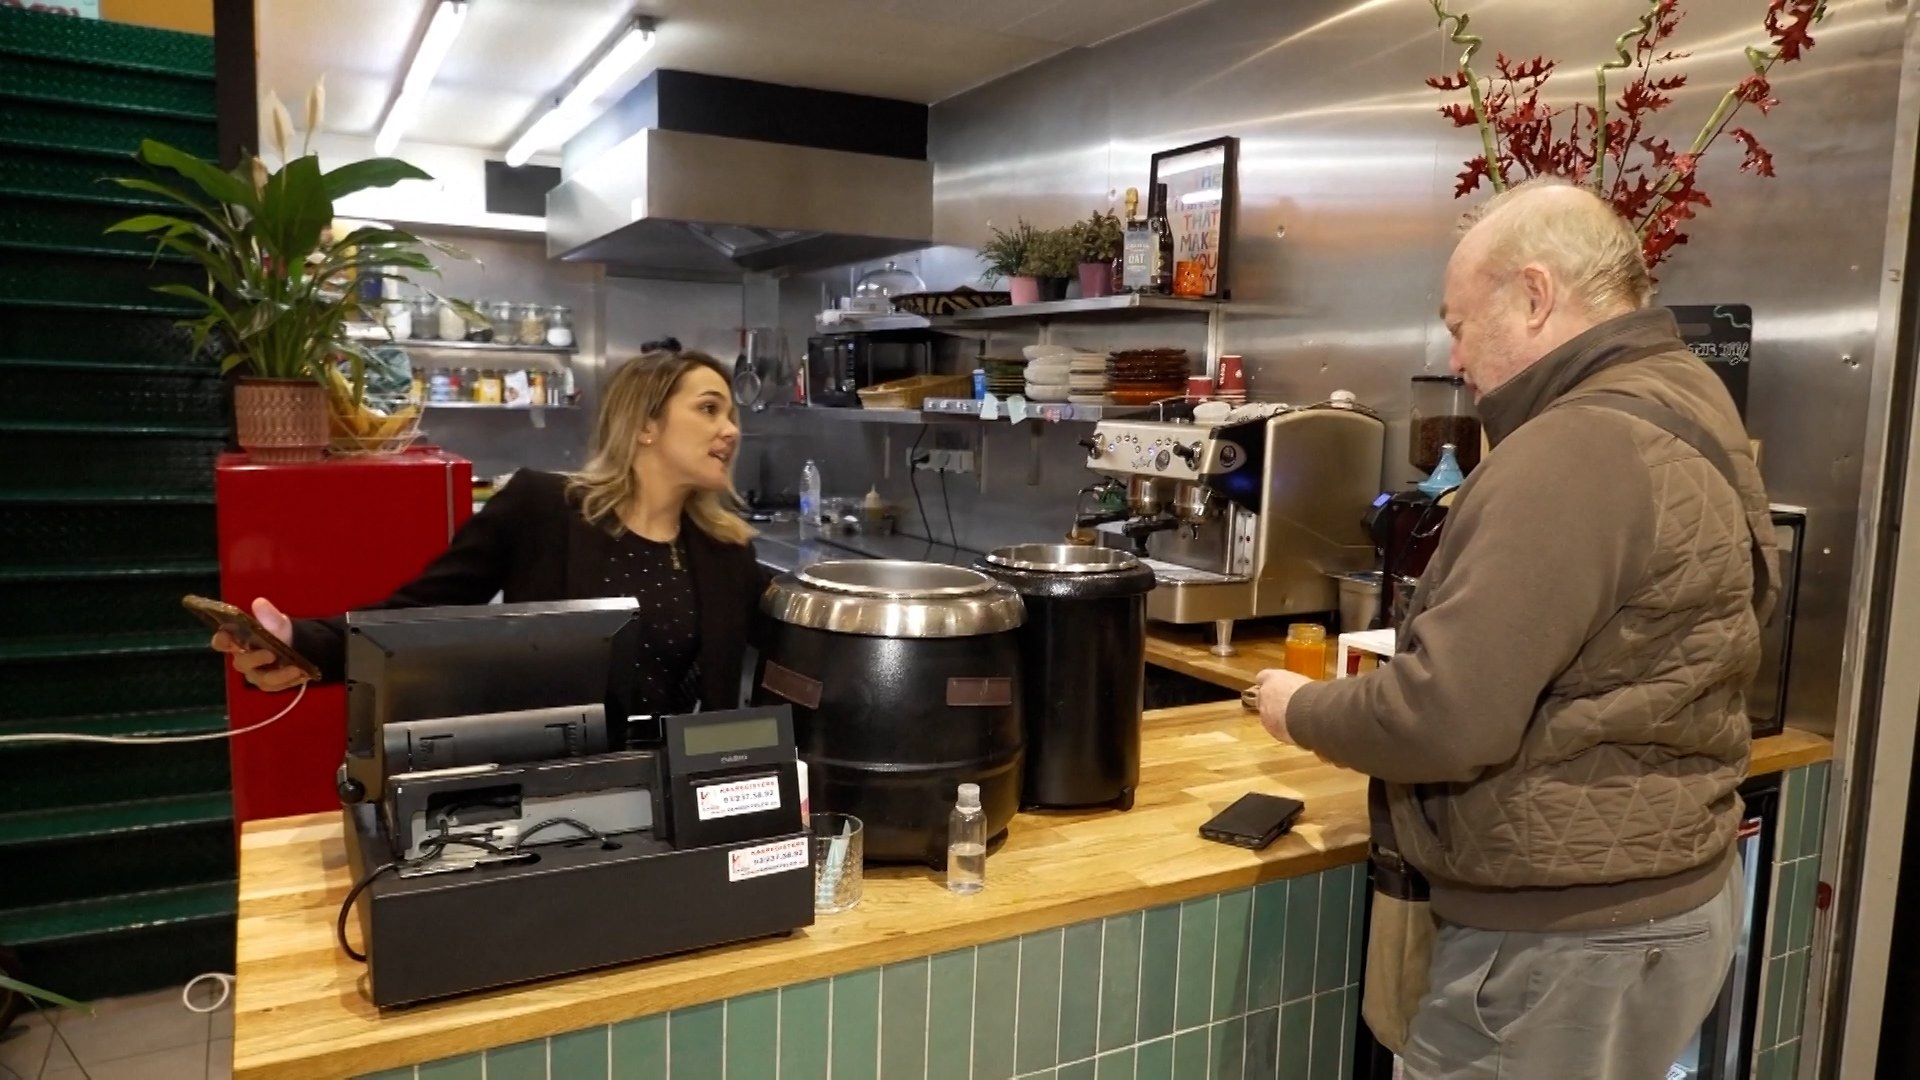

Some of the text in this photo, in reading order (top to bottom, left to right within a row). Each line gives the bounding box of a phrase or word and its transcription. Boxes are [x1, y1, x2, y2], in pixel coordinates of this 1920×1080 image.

[1184, 209, 1219, 231] THAT
[1180, 229, 1217, 252] MAKE
[1128, 253, 1145, 264] OAT
